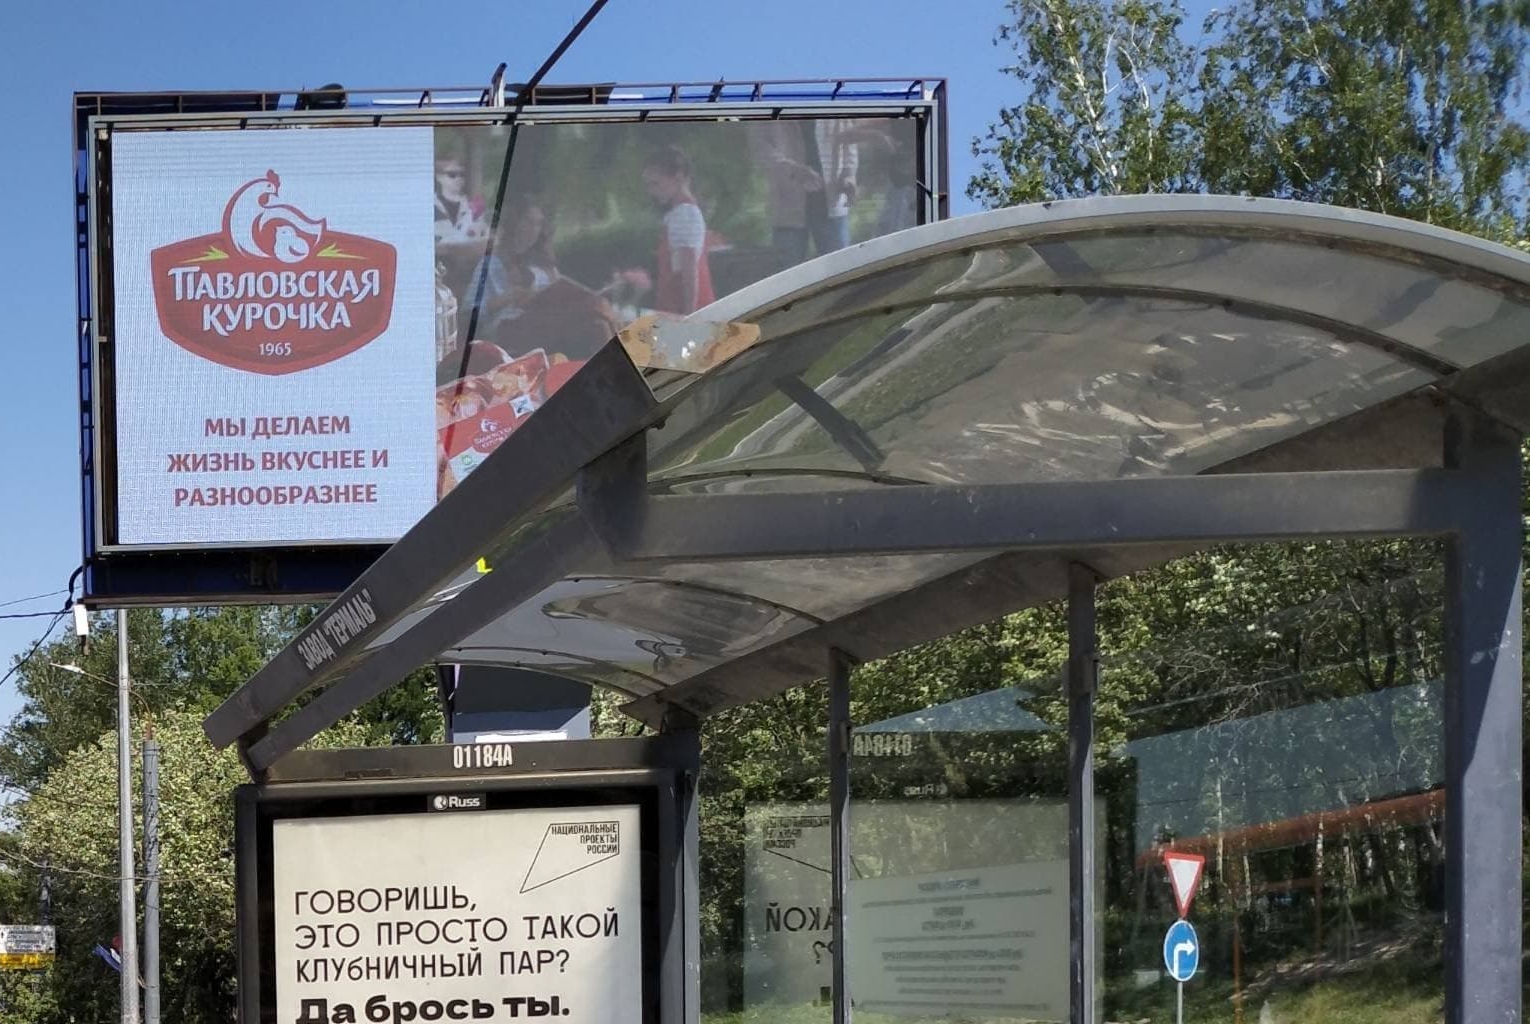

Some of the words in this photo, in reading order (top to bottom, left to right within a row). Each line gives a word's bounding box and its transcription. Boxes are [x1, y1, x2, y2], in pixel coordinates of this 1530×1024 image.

[168, 266, 380, 304] ПАВЛОВСКАЯ
[202, 301, 351, 336] КУРОЧКА
[258, 342, 291, 357] 1965
[205, 417, 246, 437] МЫ
[251, 416, 350, 440] ДЕЛАЕМ
[167, 452, 254, 473] ЖИЗНЬ
[261, 449, 366, 471] ВКУСНЕЕ
[372, 449, 388, 468] И
[174, 484, 377, 507] РАЗНООБРАЗНЕЕ
[453, 744, 513, 769] 01184A
[448, 796, 480, 808] Russ
[551, 823, 617, 836] НАЦИОНАЛЬНЫЕ
[580, 834, 617, 844] ПРОЕКТЫ
[586, 844, 617, 854] РОССИИ
[295, 885, 476, 915] ГОВОРИШЬ,
[295, 923, 360, 949] ЭТО
[377, 917, 507, 946] ПРОСТО
[522, 907, 619, 941] ТАКОЙ
[500, 949, 570, 975] ПАР?
[502, 996, 570, 1018] ты.
